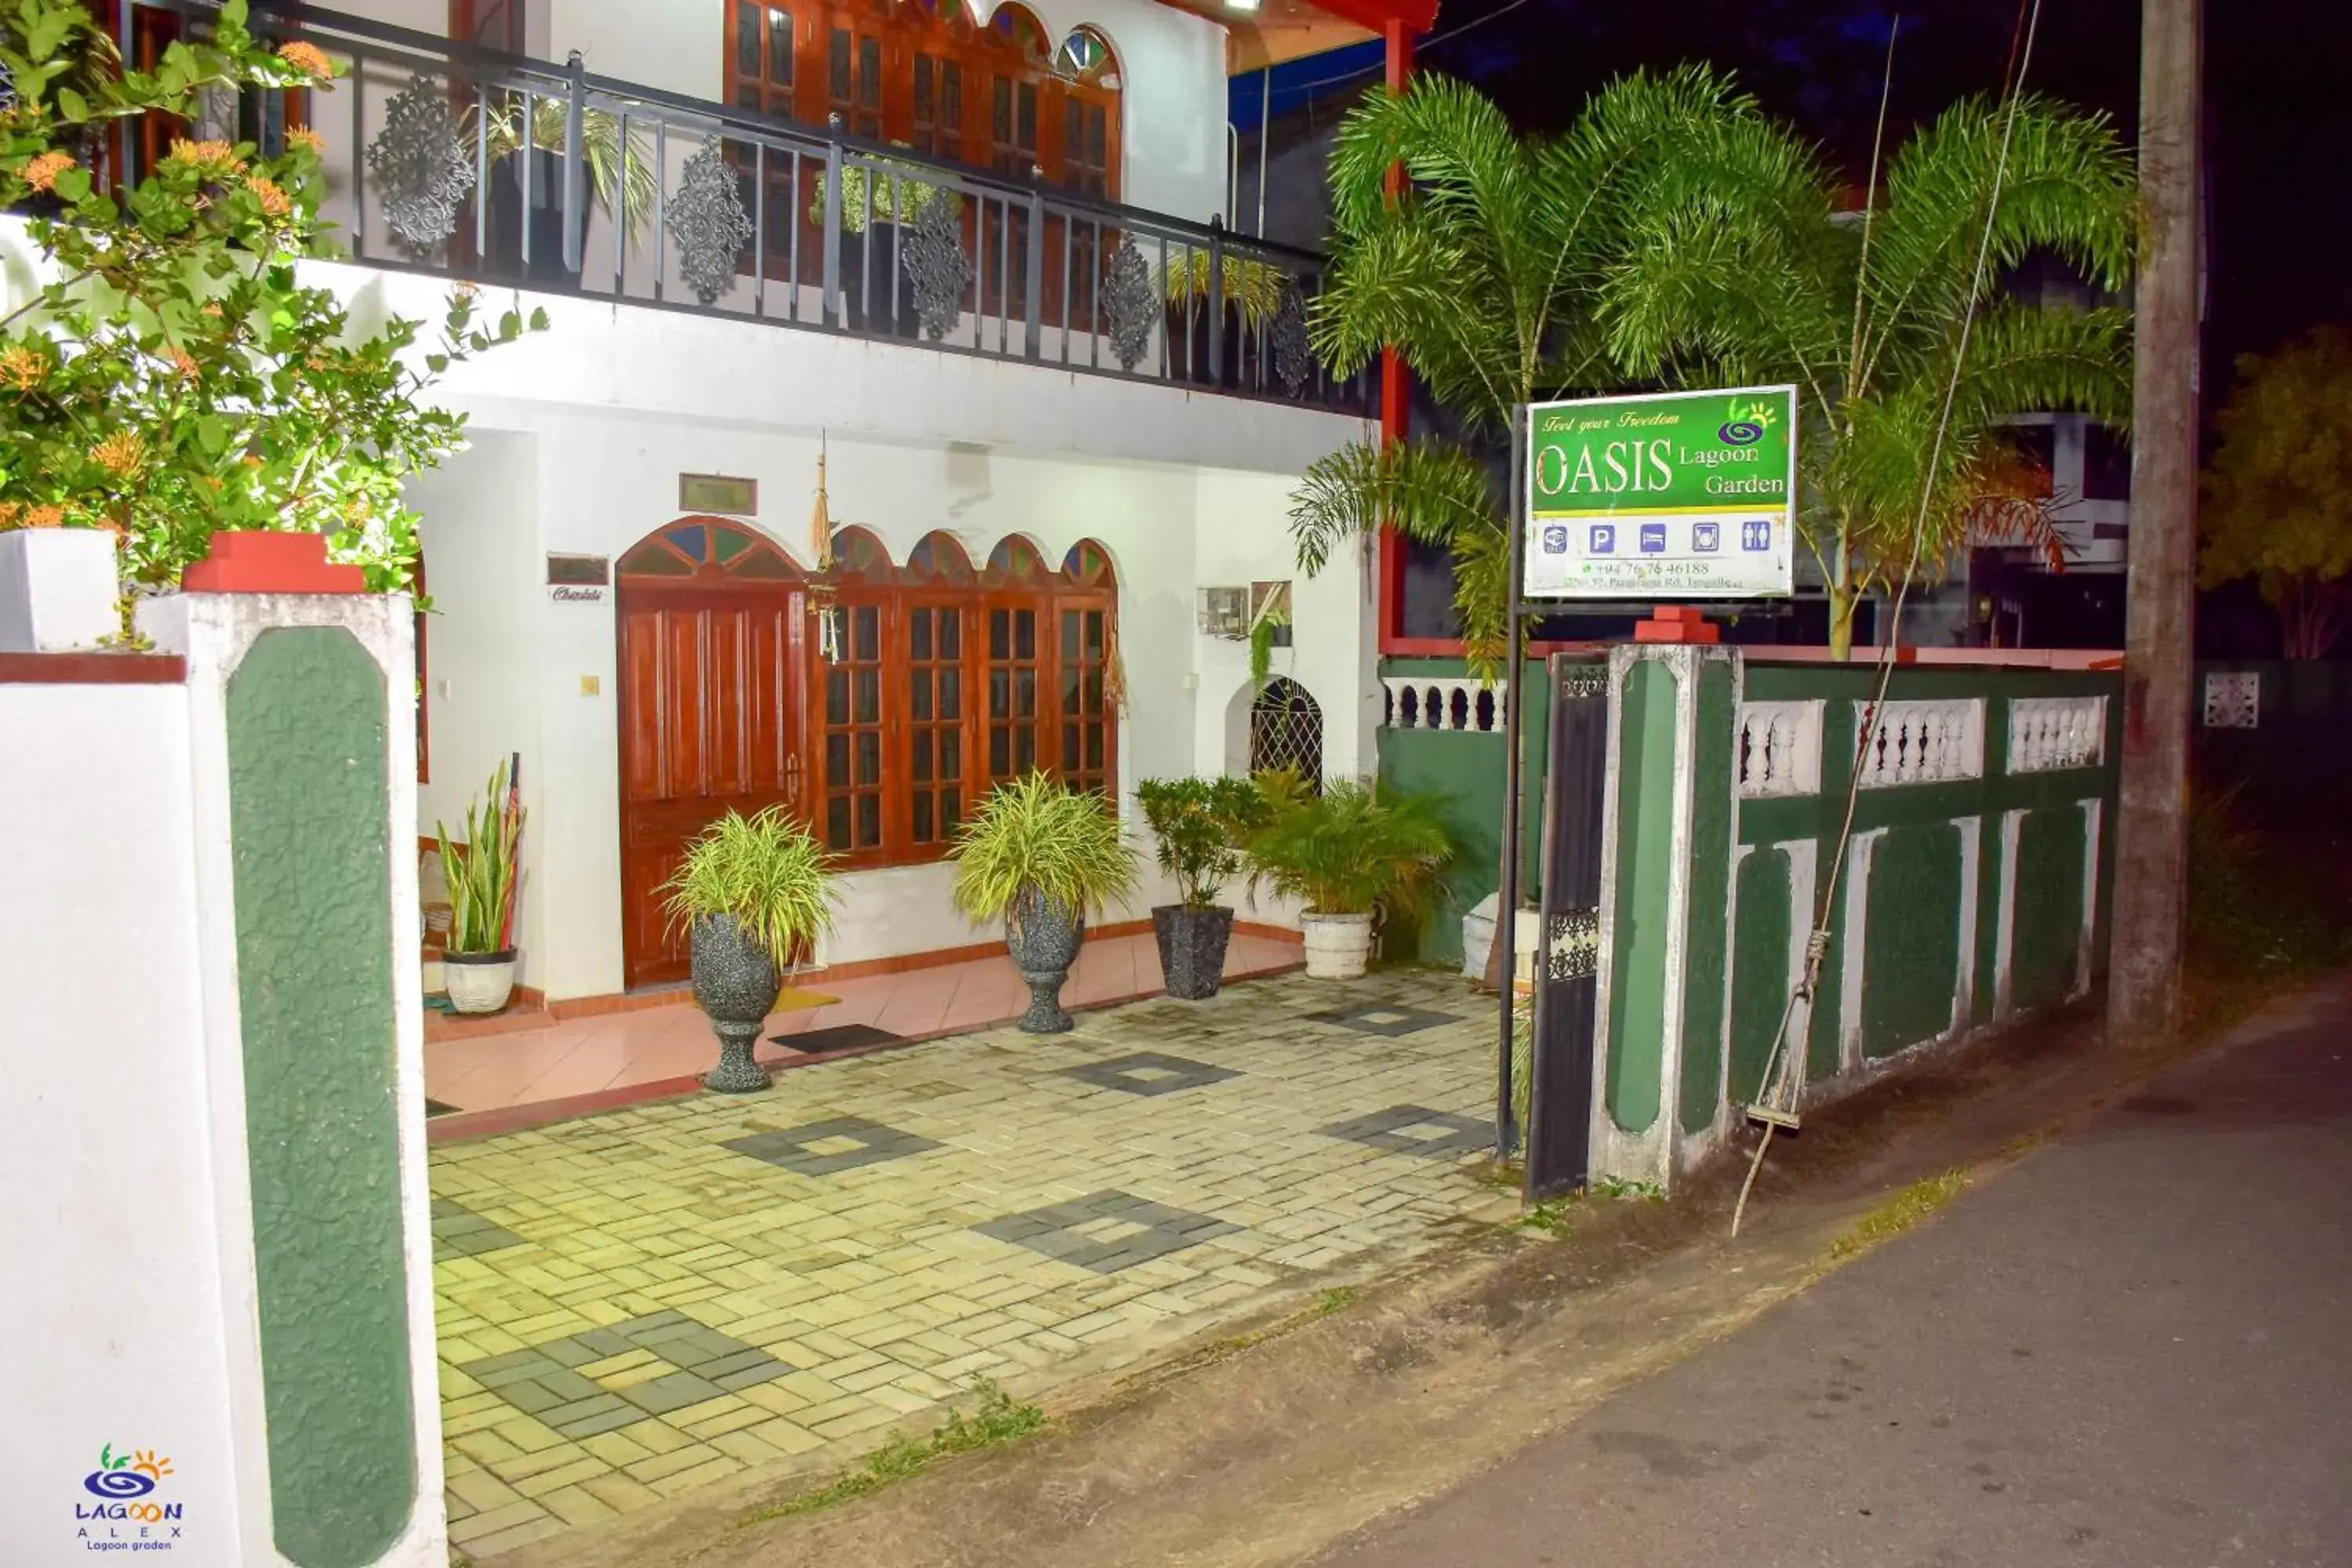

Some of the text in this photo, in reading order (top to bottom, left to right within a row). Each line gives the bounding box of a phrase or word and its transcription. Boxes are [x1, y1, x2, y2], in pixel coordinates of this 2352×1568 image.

[1543, 411, 1680, 435] Feel your Freedom
[1536, 438, 1759, 495] OASIS Lagoon
[1705, 474, 1784, 495] Garden
